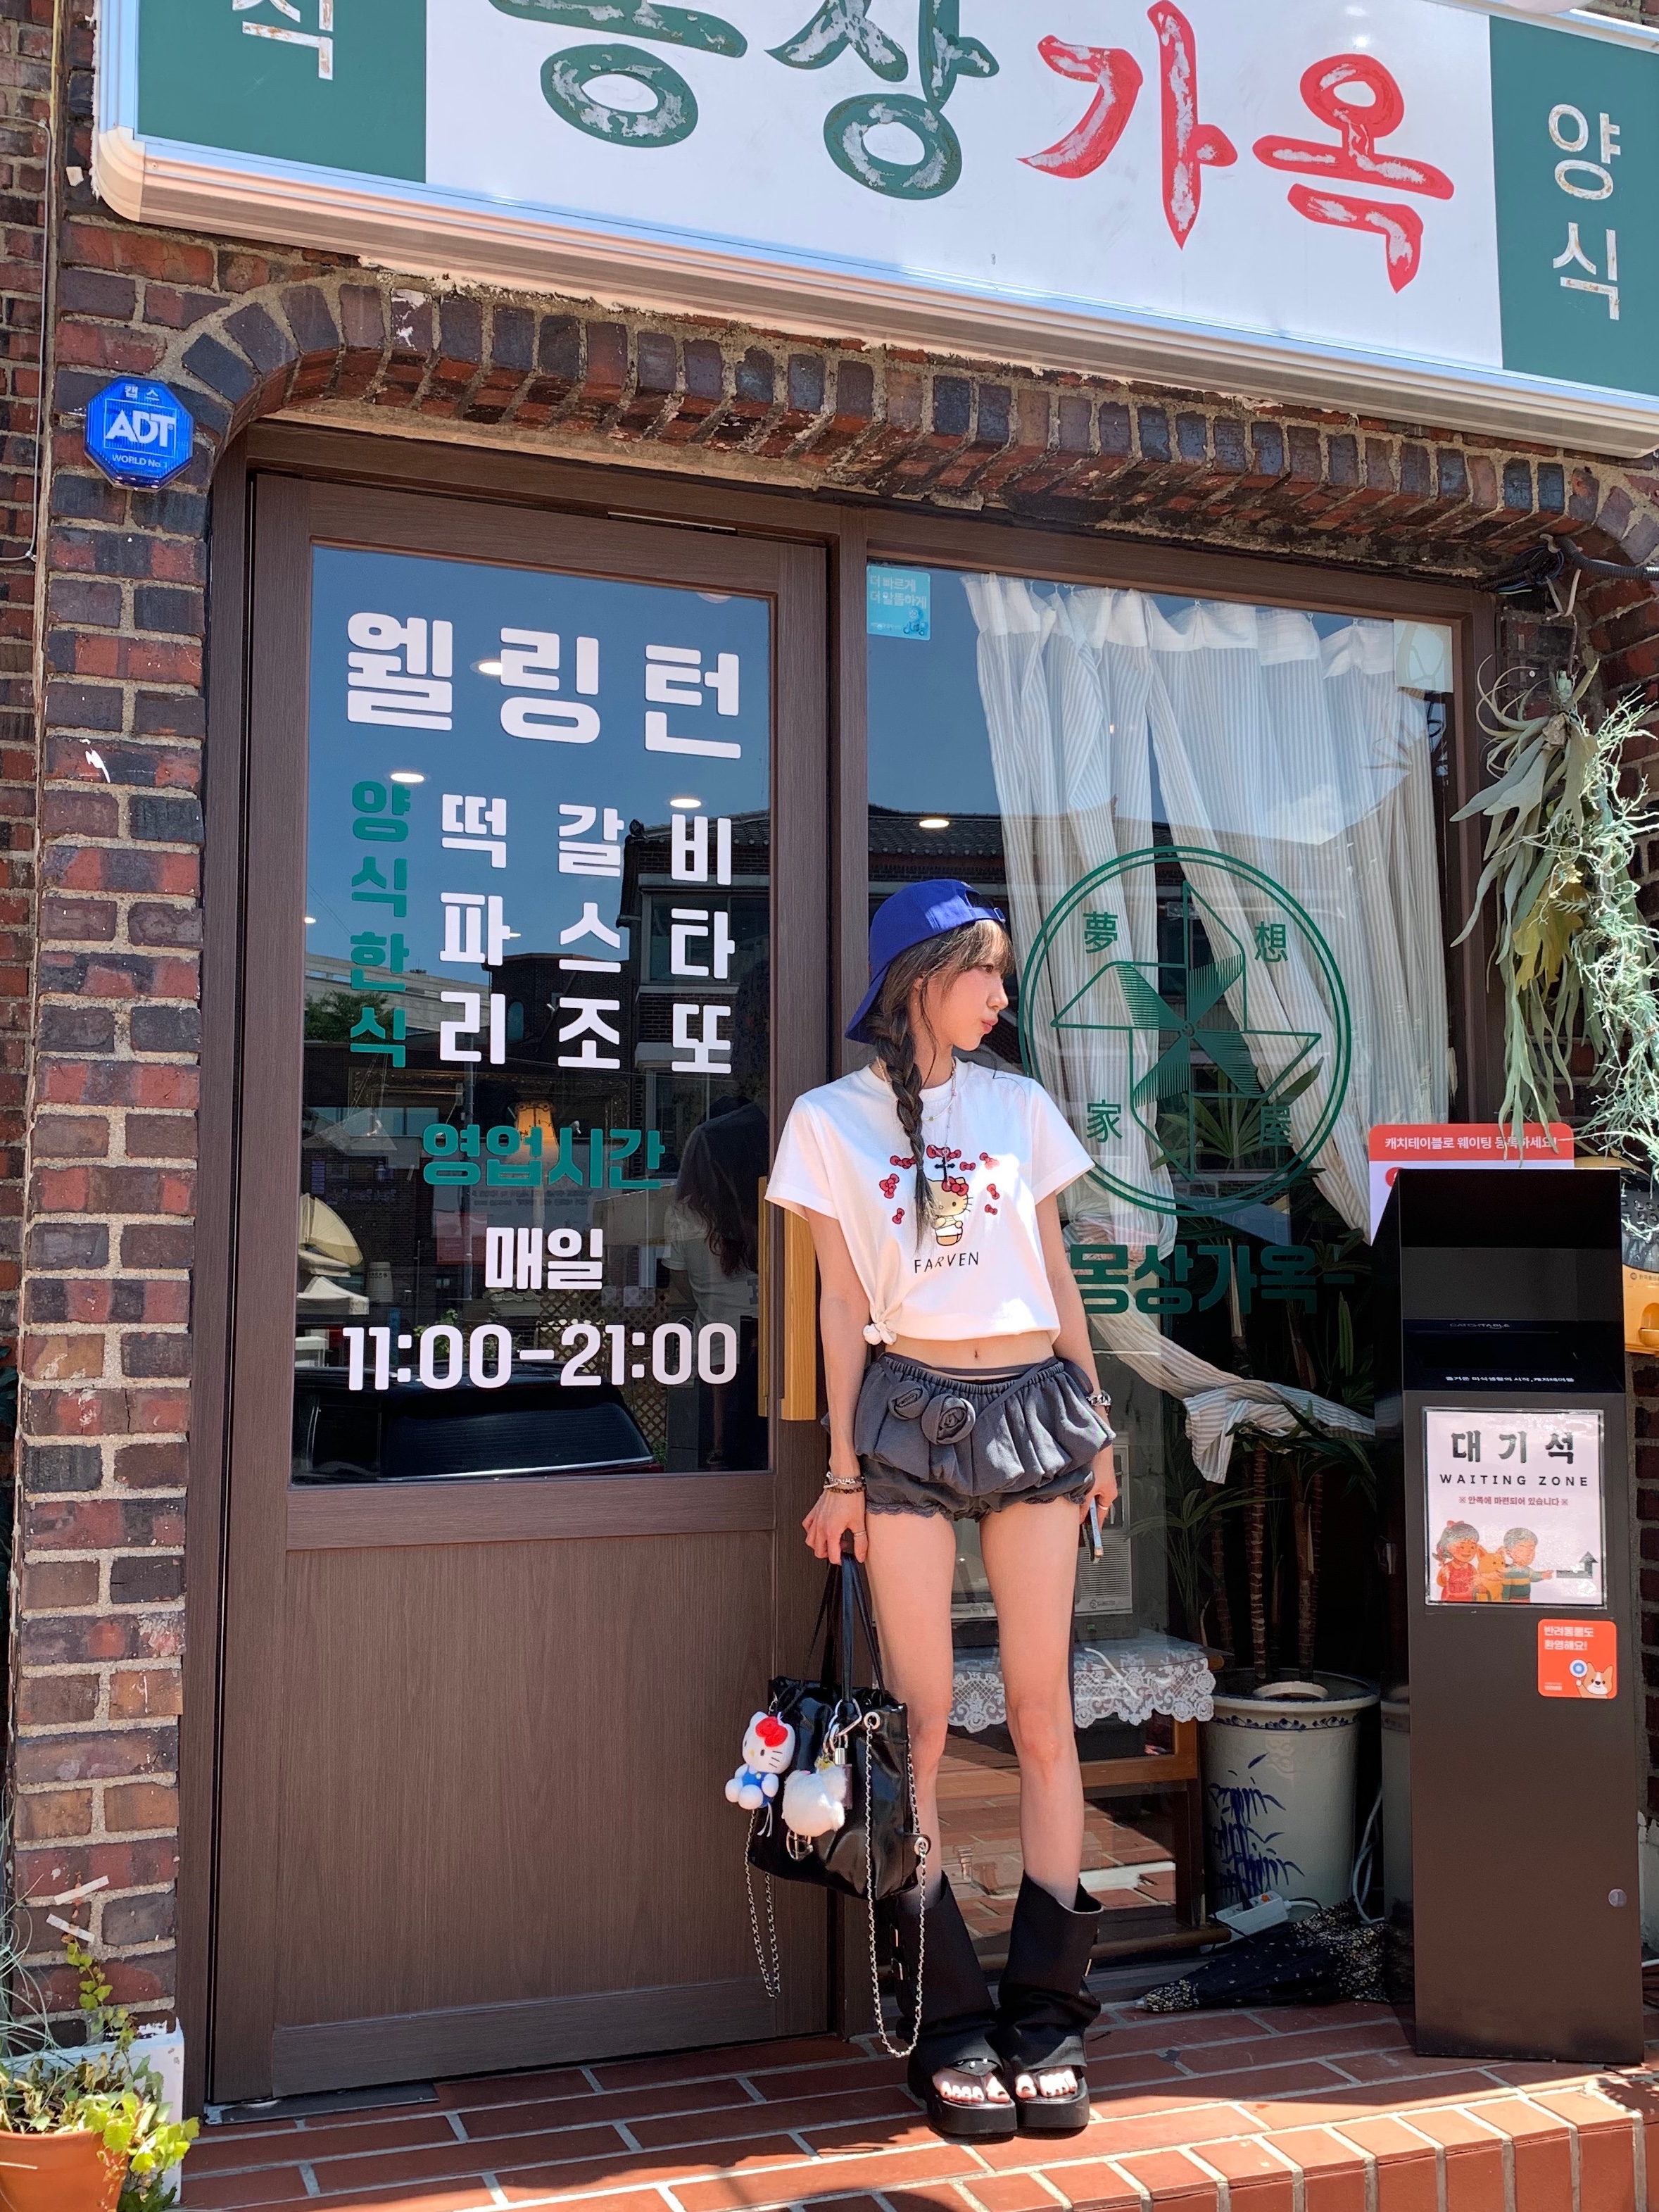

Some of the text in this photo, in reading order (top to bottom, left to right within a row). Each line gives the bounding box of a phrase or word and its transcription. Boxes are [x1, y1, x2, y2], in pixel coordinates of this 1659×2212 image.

[1548, 102, 1622, 321] 양식
[125, 384, 160, 401] 캡스
[106, 409, 177, 448] ADT
[112, 454, 146, 466] WORLD
[347, 612, 741, 759] 웰링턴
[441, 793, 731, 886] 떡갈비
[439, 892, 736, 980] 파스타
[1083, 911, 1289, 962] 夢 想
[440, 991, 731, 1074] 리조또
[1086, 1099, 1123, 1143] 家
[422, 1123, 665, 1189] 영업시간
[1384, 1136, 1454, 1150] 캐치테이블로
[1457, 1136, 1491, 1150] 웨이팅
[485, 1227, 603, 1290] 매일
[914, 1252, 979, 1274] FARVEN
[1450, 1430, 1575, 1464] 대기석
[1439, 1474, 1588, 1486] WAITING ZONE
[1468, 1496, 1559, 1506] 안쪽에 마련되어 있습니다
[1544, 1626, 1594, 1638] 반려동물도
[1544, 1640, 1588, 1651] 환영해요!
